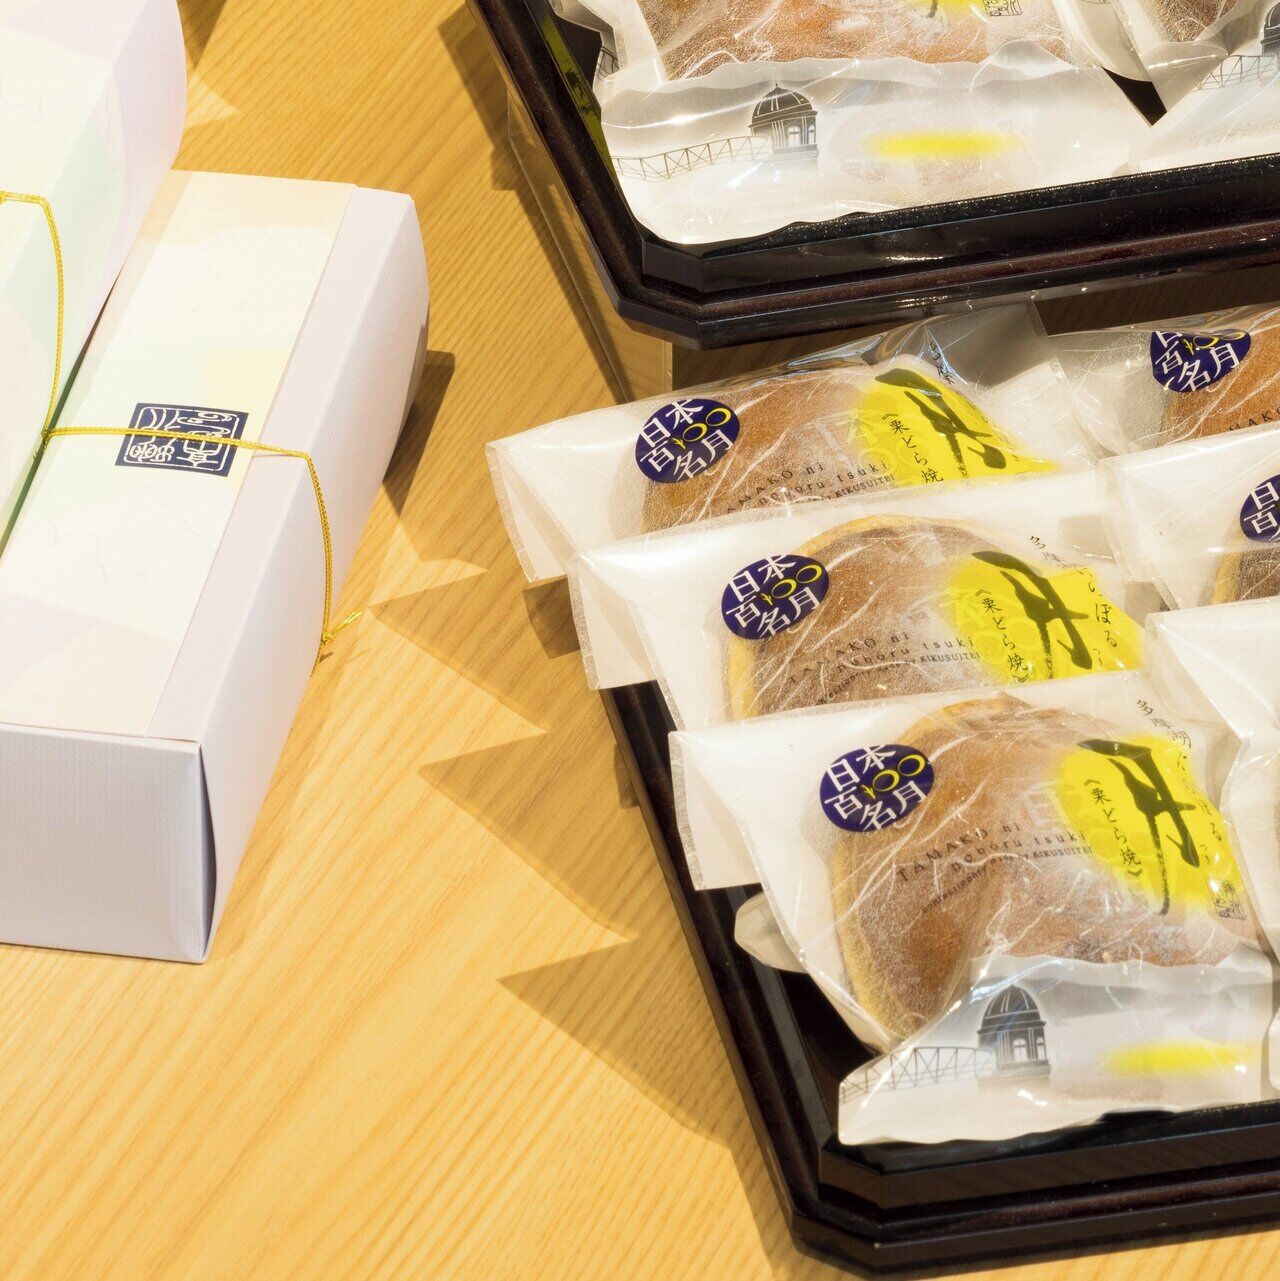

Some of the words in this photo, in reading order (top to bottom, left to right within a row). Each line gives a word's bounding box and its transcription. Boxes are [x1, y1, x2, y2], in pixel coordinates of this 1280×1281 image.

[1178, 342, 1240, 391] 名月
[639, 399, 704, 448] 日本
[673, 429, 733, 481] 名月
[729, 554, 796, 602] 日本
[757, 588, 819, 637] 名月
[828, 746, 896, 791] 日本
[860, 781, 927, 830] 名月
[1077, 739, 1200, 916] 月
